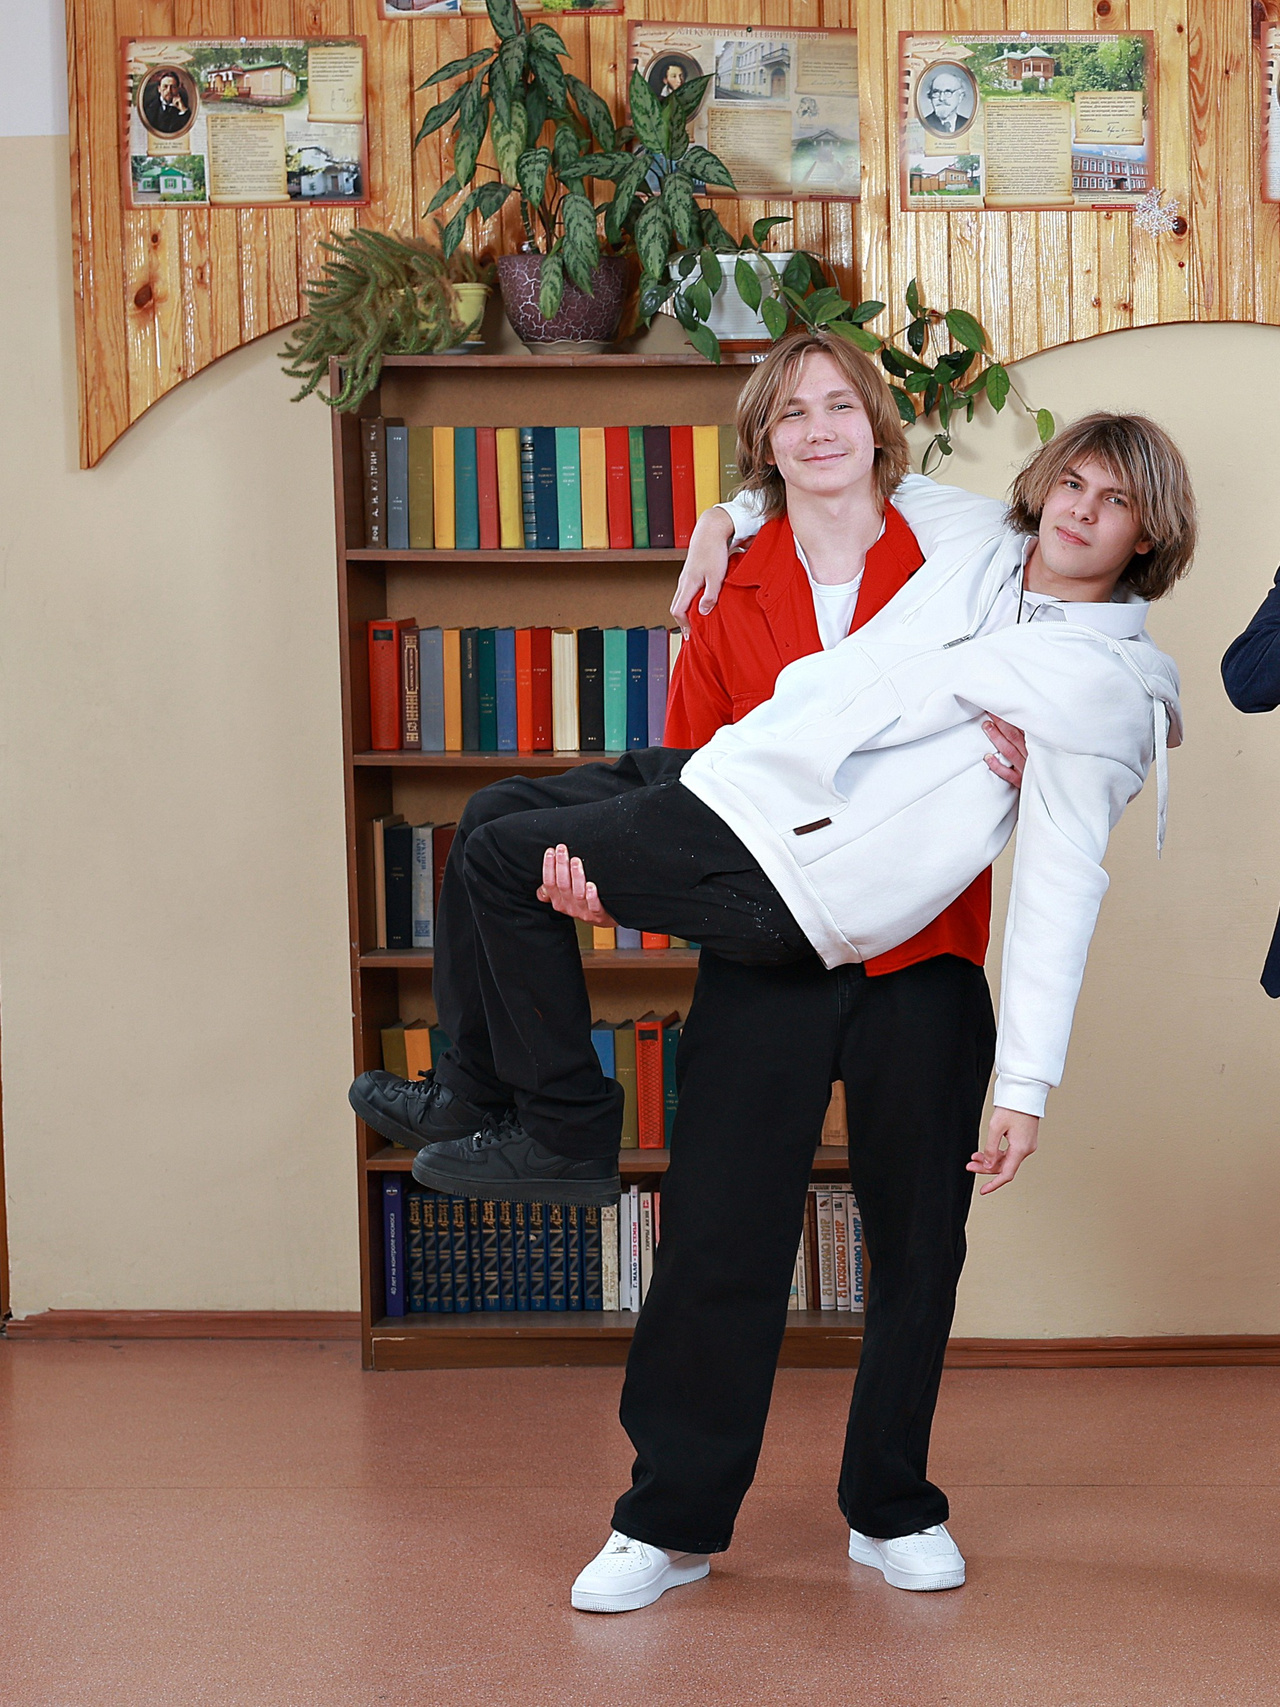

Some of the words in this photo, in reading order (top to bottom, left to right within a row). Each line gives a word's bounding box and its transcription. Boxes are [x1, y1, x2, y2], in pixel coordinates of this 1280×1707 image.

[821, 1218, 831, 1240] МИР
[835, 1220, 845, 1243] МИР
[853, 1218, 862, 1242] МИР
[821, 1243, 832, 1286] ПОЗНАЮ
[836, 1245, 847, 1288] ПОЗНАЮ
[855, 1245, 863, 1291] ПОЗНАЮ
[391, 1287, 396, 1295] 40
[822, 1288, 832, 1296] Я
[838, 1290, 847, 1298] Я
[855, 1294, 863, 1303] Я
